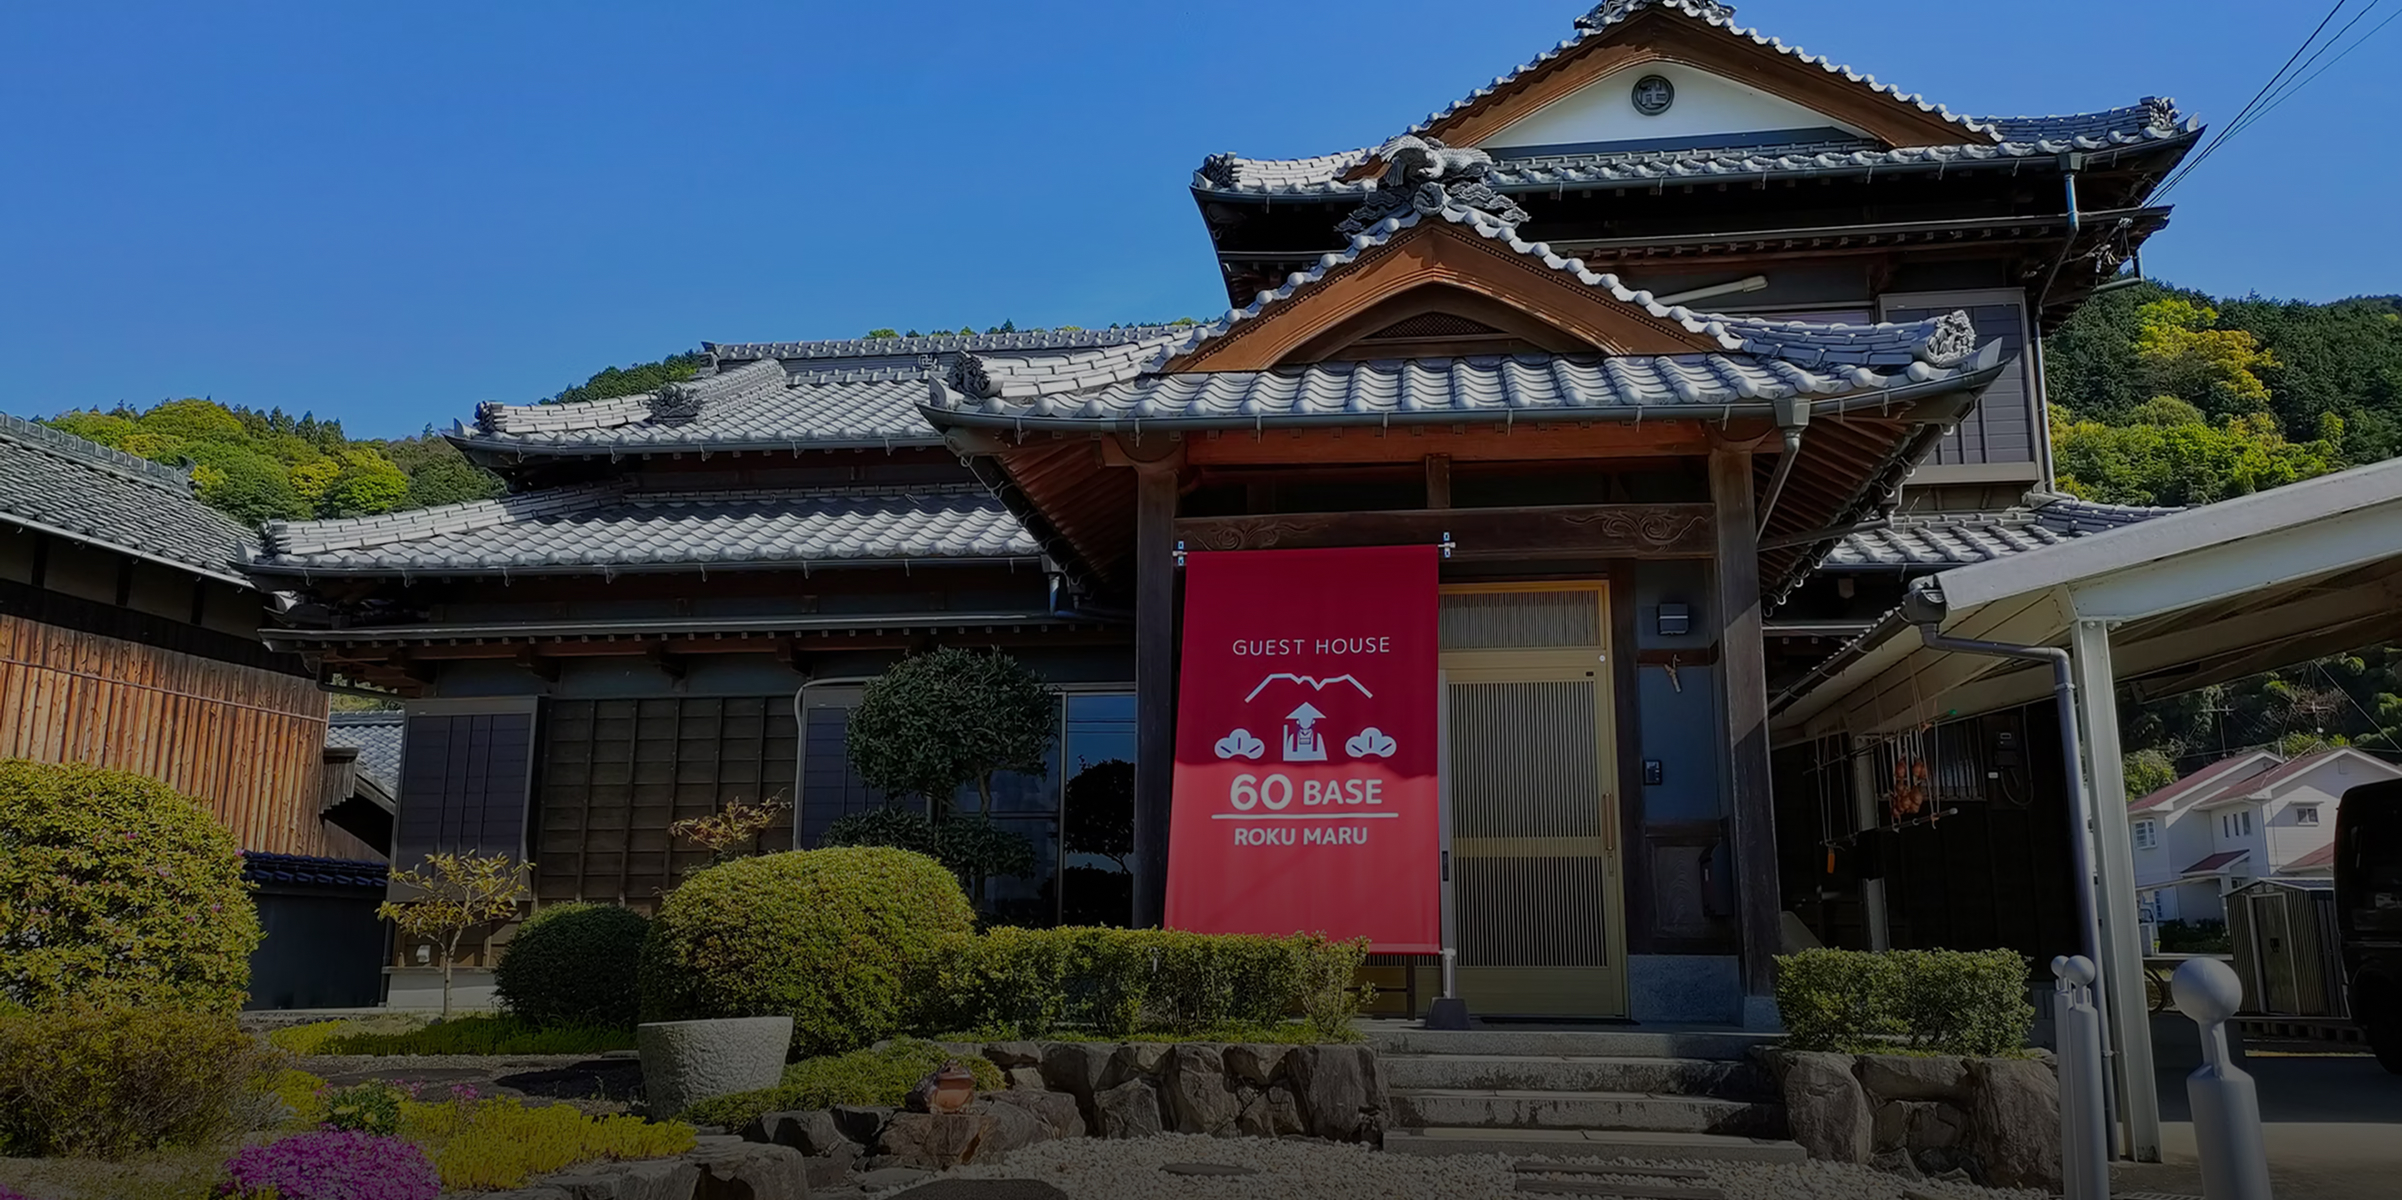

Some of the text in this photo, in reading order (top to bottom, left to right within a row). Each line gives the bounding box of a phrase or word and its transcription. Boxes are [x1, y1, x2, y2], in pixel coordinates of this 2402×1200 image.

[1232, 636, 1391, 657] GUEST HOUSE
[1230, 773, 1383, 811] 60 BASE
[1233, 826, 1368, 847] ROKU MARU
